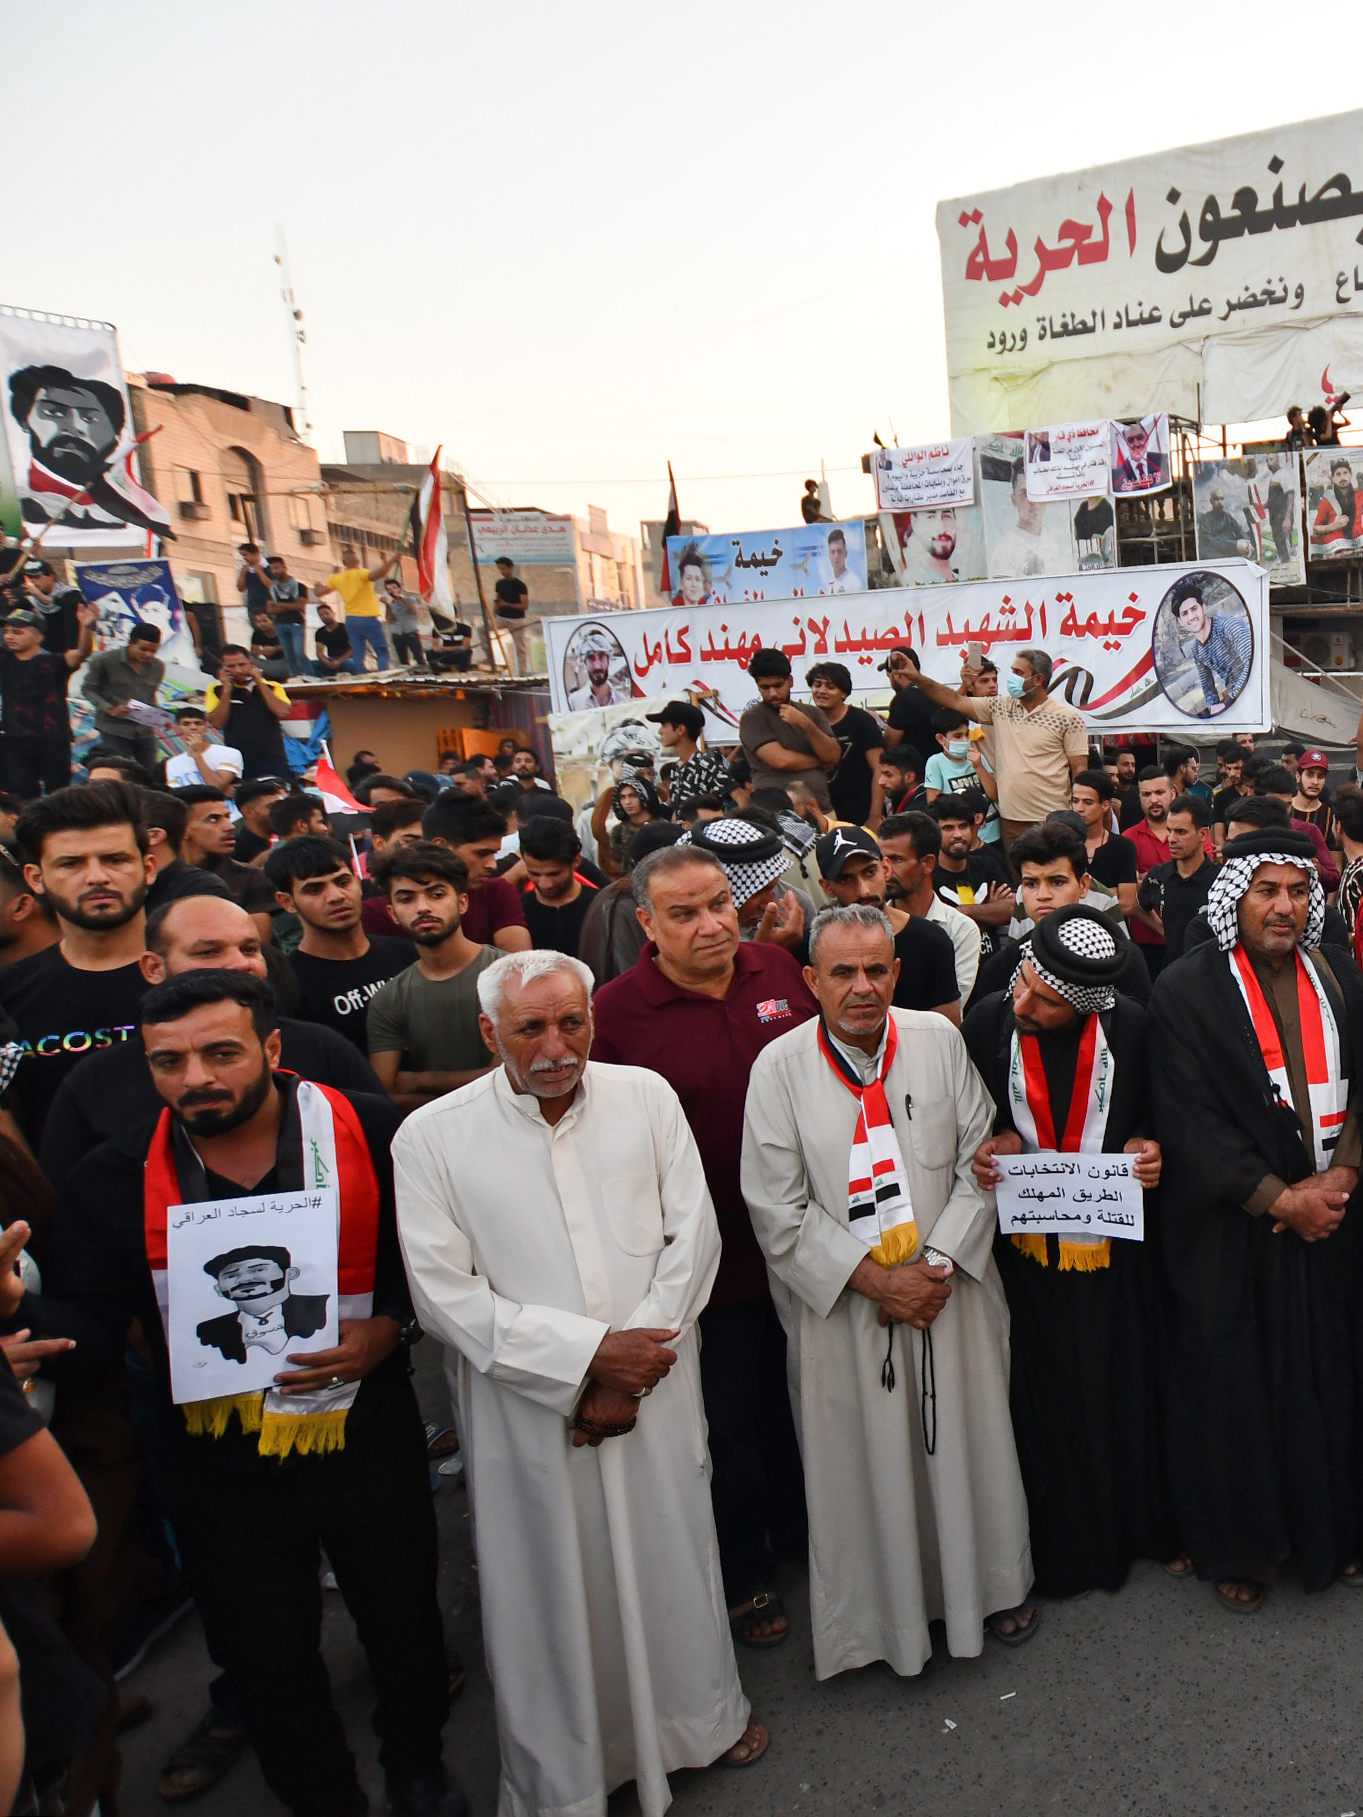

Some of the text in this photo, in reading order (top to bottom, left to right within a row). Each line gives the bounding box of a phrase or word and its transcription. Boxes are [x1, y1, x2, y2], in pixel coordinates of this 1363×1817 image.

[957, 185, 1137, 308] الحرية
[1112, 300, 1163, 330] عناد
[1168, 293, 1213, 329] على
[1217, 275, 1305, 321] ونخضر
[986, 329, 1028, 355] ورود
[1035, 306, 1106, 342] الطغاة
[1077, 427, 1100, 438] محافظ
[731, 538, 784, 577] خيمة
[935, 593, 1048, 660] الشهيد
[1055, 590, 1147, 652] خيمة
[633, 624, 692, 678] كامل
[699, 622, 763, 671] مهند
[1008, 1162, 1129, 1179] قانون الانتخابات
[172, 1195, 323, 1230] #الحرية لسجاد العراقي
[1018, 1187, 1123, 1203] الطريق المهلك
[1010, 1209, 1135, 1227] للقتلة ومحاسبتهم
